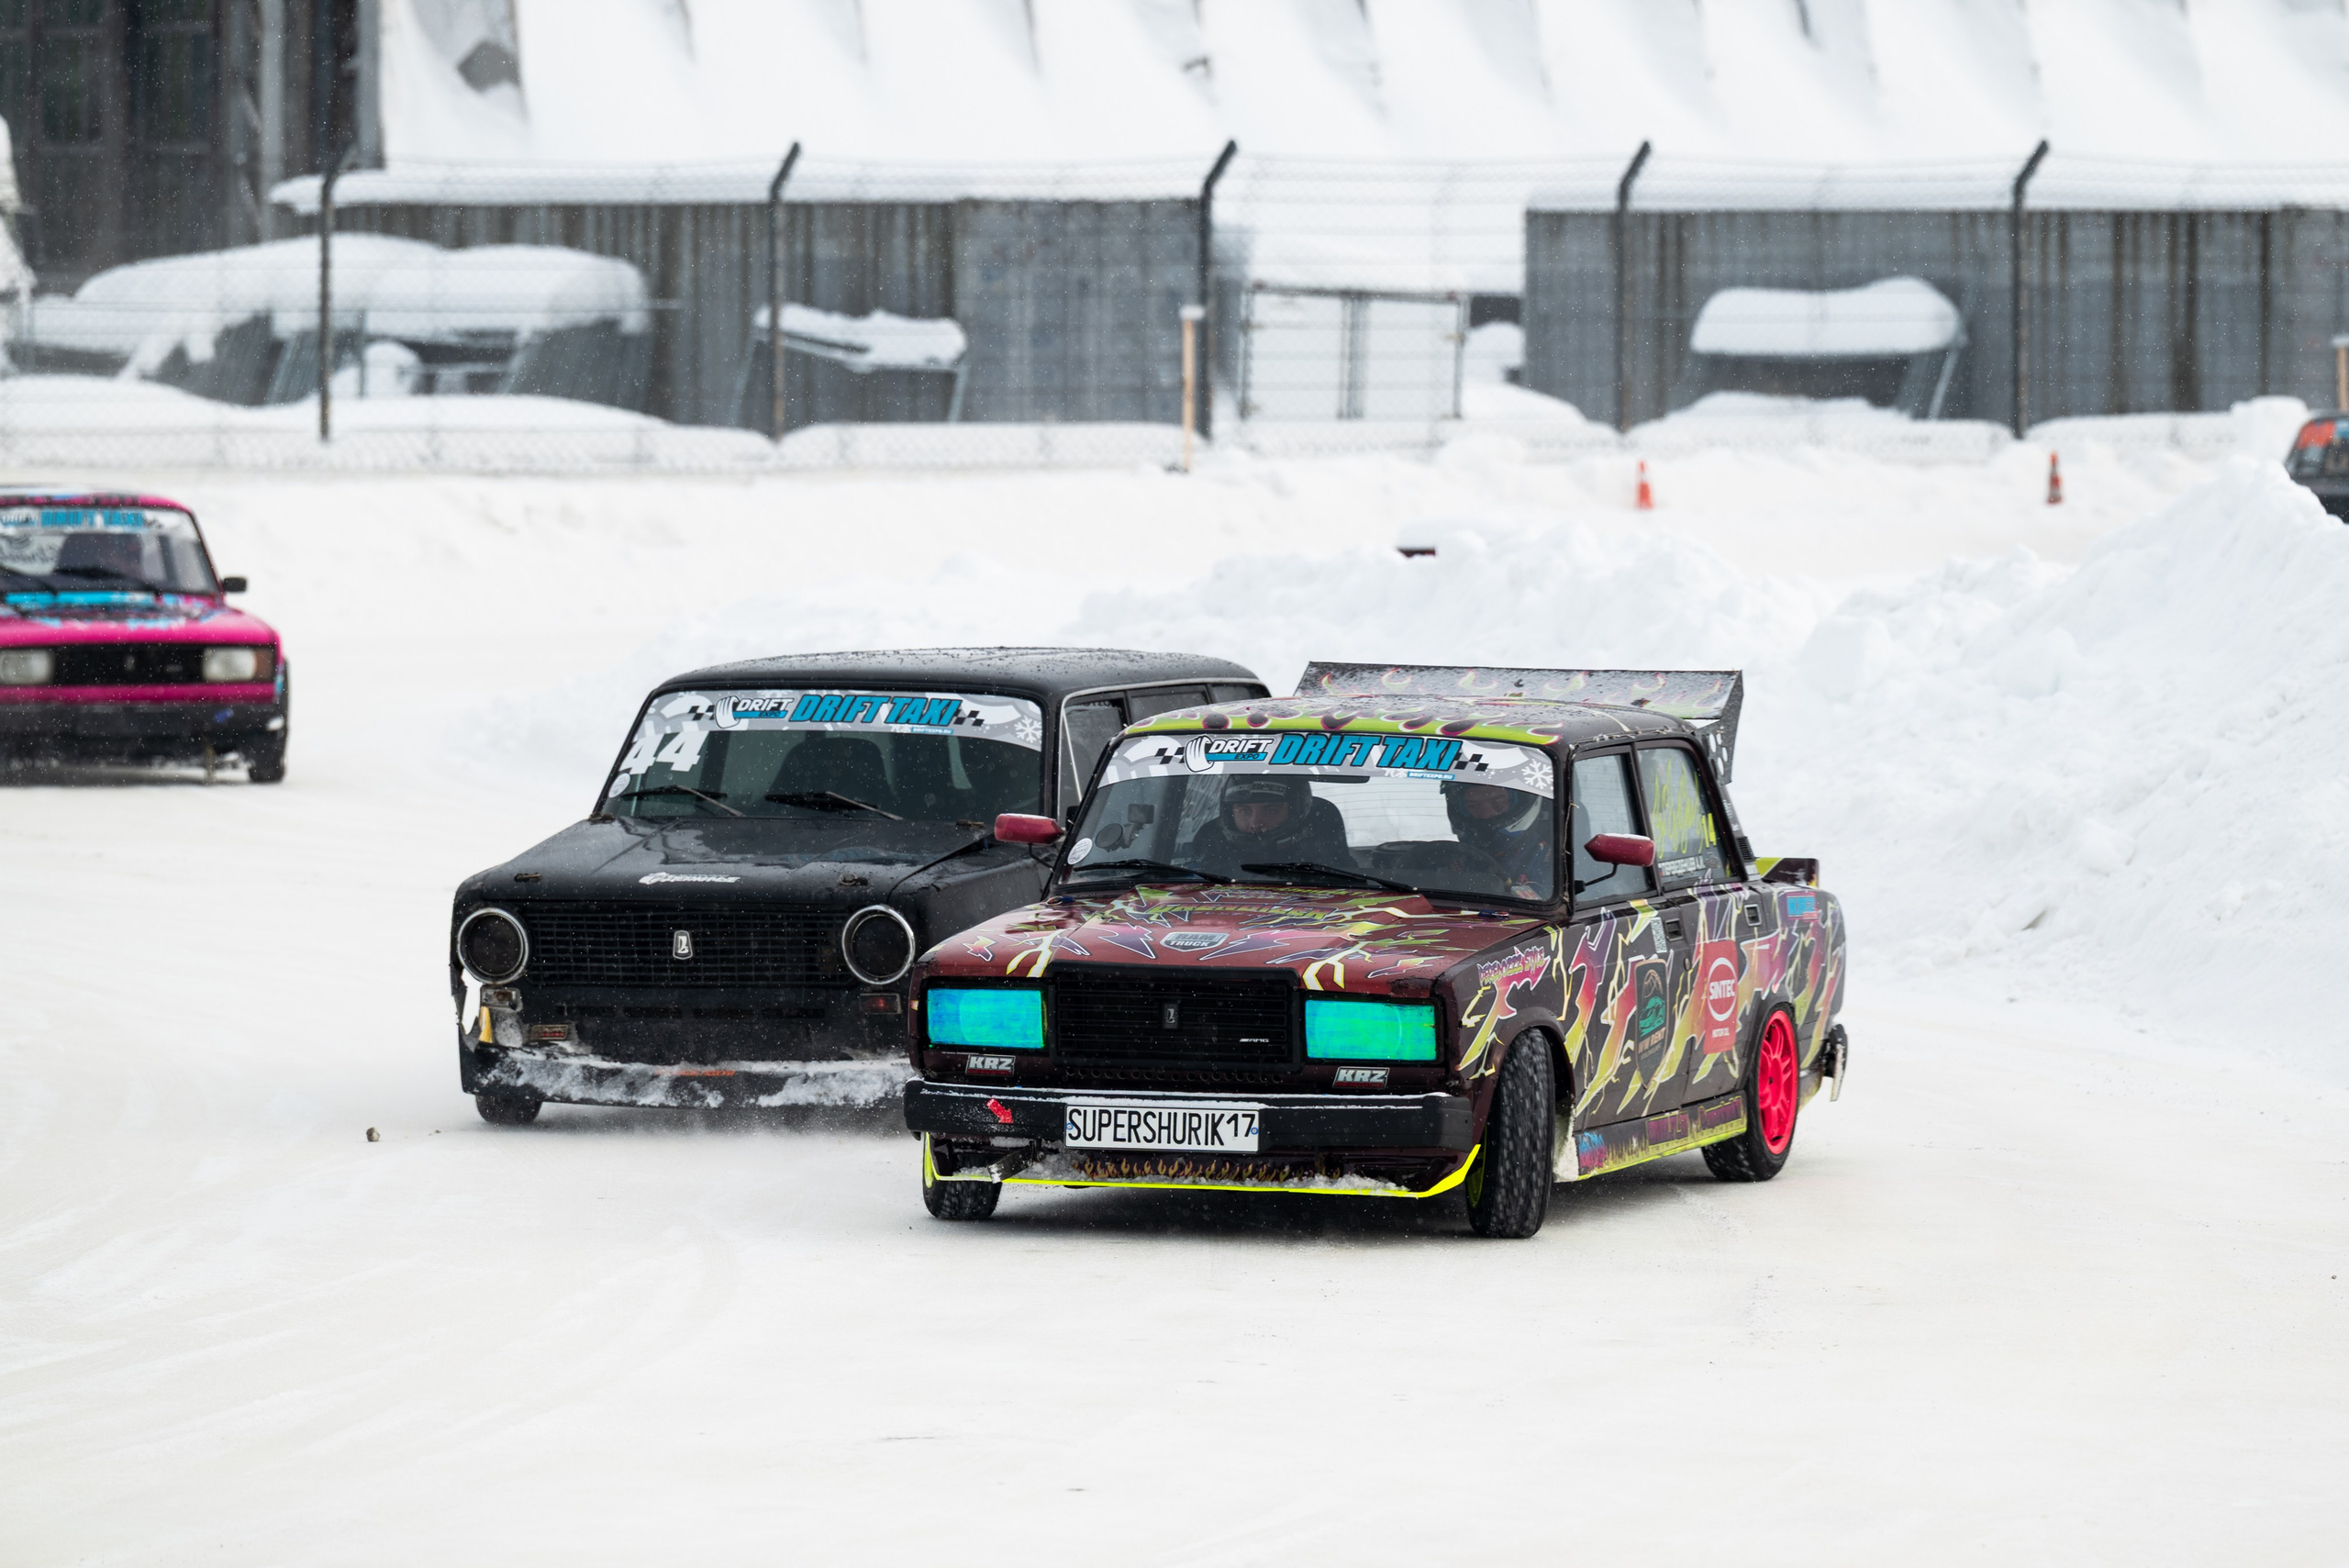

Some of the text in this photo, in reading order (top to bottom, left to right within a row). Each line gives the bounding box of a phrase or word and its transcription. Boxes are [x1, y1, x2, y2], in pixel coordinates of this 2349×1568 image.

[736, 698, 794, 711] DRIFT
[789, 695, 963, 726] DRIFT TAXI
[618, 730, 710, 775] 44
[1209, 739, 1274, 753] DRIFT
[1269, 733, 1464, 772] DRIFT TAXI
[1709, 979, 1736, 1000] SINTEC
[968, 1056, 1014, 1070] KRZ
[1336, 1069, 1387, 1083] KRZ
[1067, 1108, 1256, 1146] SUPERSHURIK17
